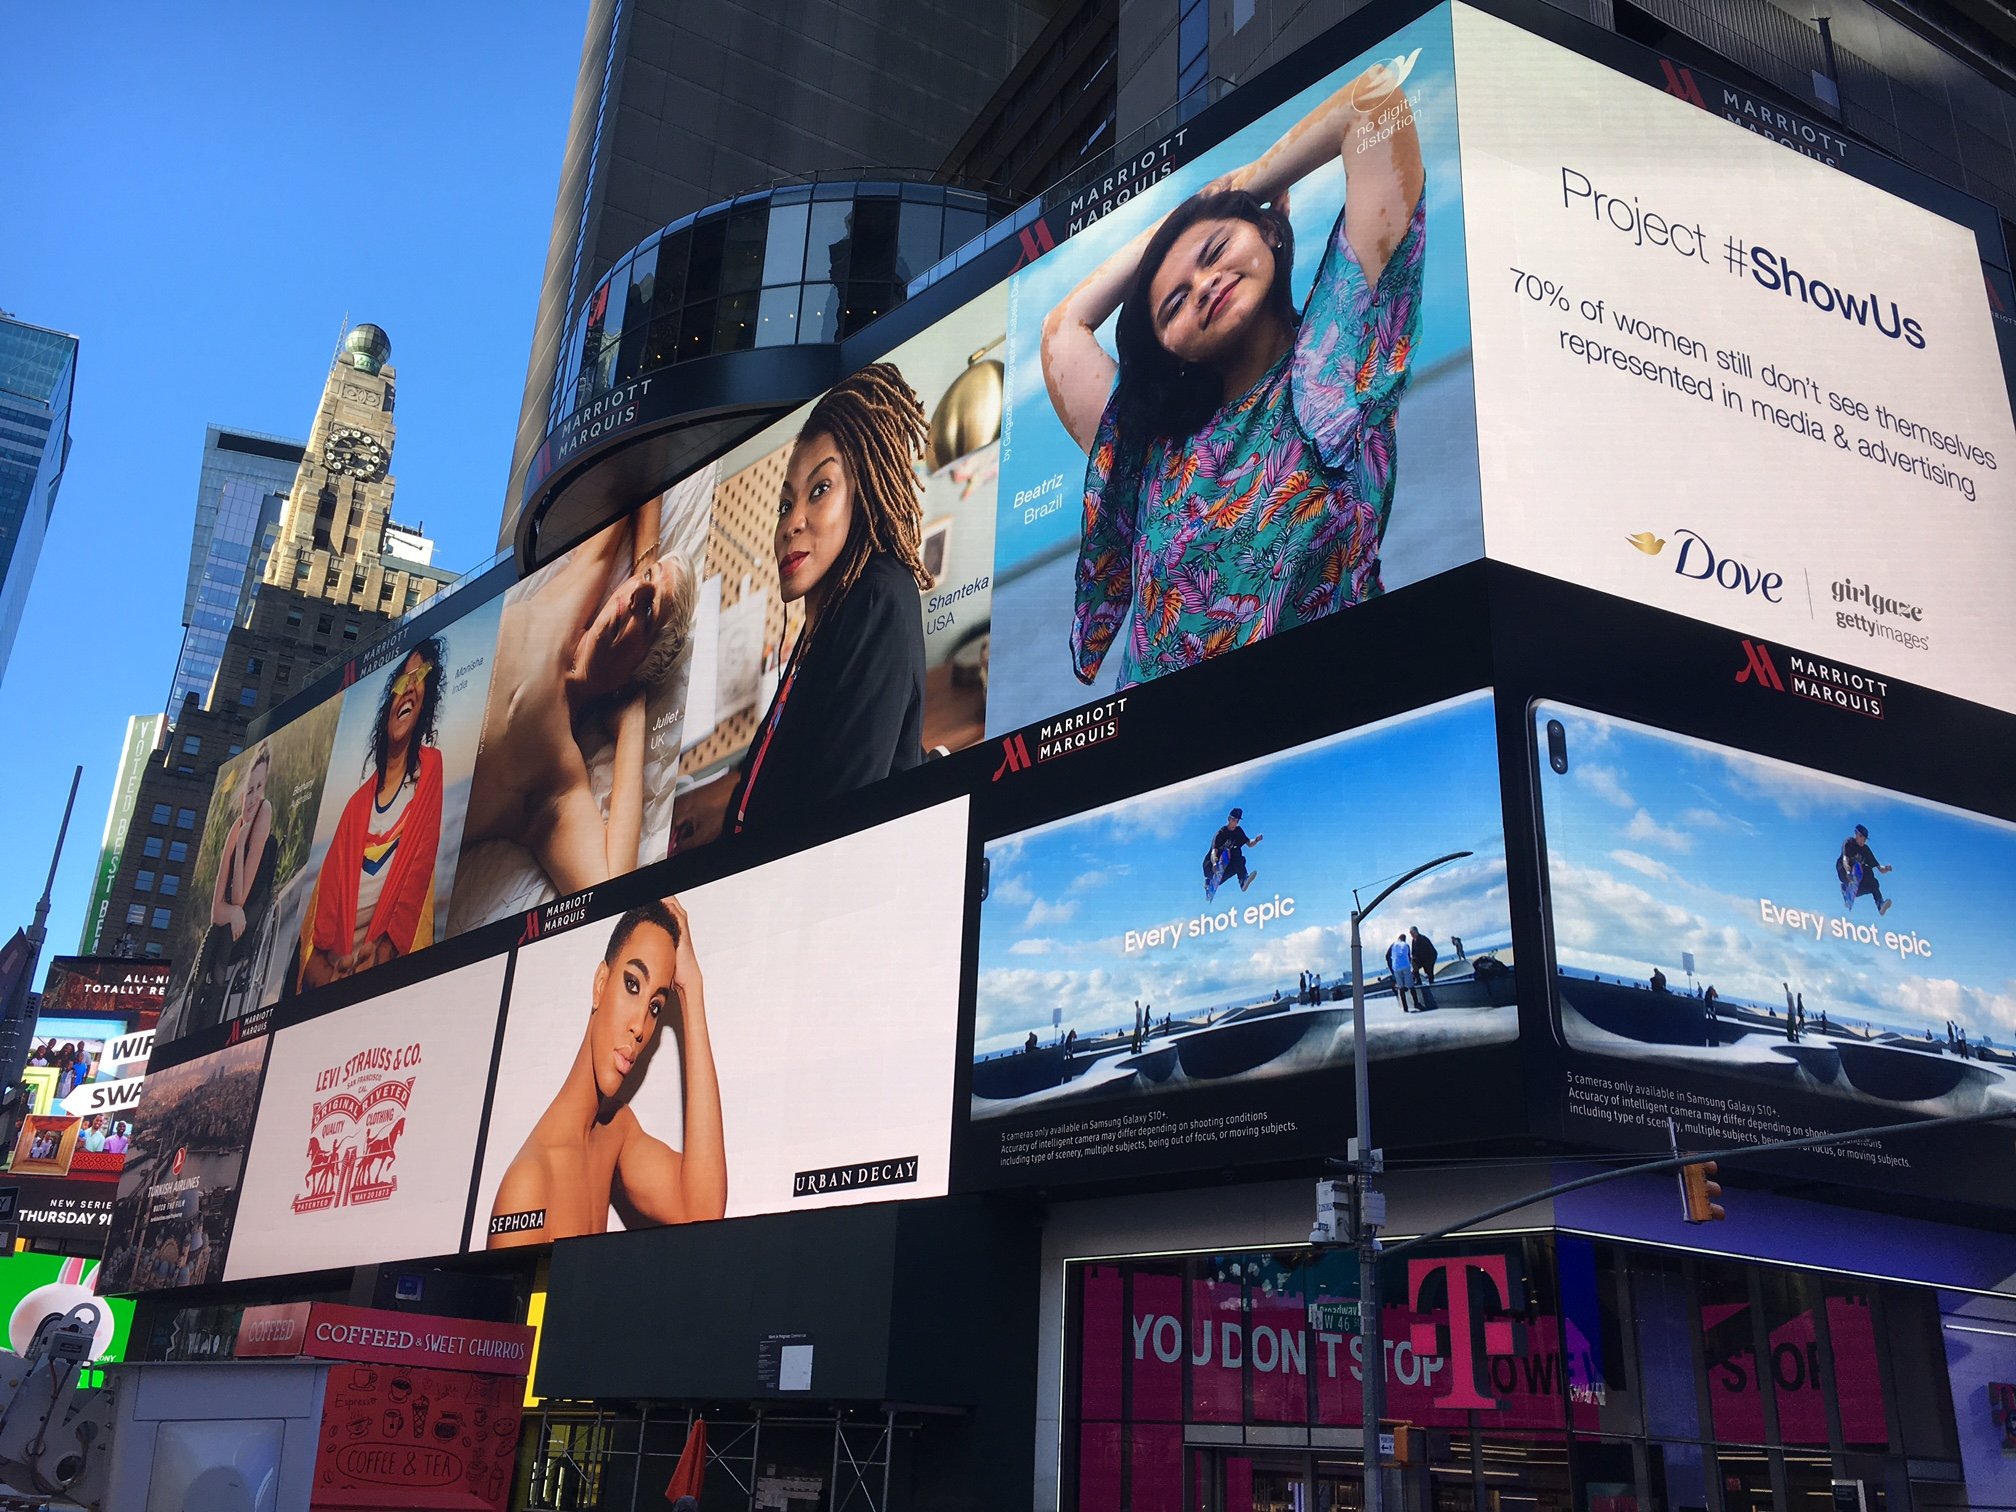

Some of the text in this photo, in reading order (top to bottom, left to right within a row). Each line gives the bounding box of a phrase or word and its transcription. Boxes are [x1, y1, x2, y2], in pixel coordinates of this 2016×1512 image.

[1356, 109, 1422, 154] distortion
[1357, 89, 1421, 139] no digital
[1723, 88, 1847, 157] MARRIOTT
[1070, 128, 1188, 216] MARRIOTT
[1068, 161, 1172, 238] MARQUIS
[1561, 166, 1926, 350] Project #ShowUs
[1509, 266, 1998, 470] 70% of women still don't see themselves
[561, 379, 652, 438] MARRIOTT
[1559, 329, 1977, 502] represented in media & advertising
[558, 406, 635, 460] MARQUIS
[1013, 473, 1064, 509] Beatriz
[1024, 494, 1063, 525] Brazil
[1674, 528, 1784, 604] Dove
[927, 576, 989, 613] Shanteka
[1831, 577, 1924, 622] girlgaze
[926, 611, 955, 635] USA
[1835, 610, 1930, 651] gettyimages
[359, 646, 401, 678] MARQUIS
[363, 627, 409, 664] MARRIOTT
[452, 679, 468, 694] India
[454, 656, 485, 680] Monisha
[1791, 656, 1888, 698] MARRIOTT
[1793, 677, 1881, 716] MARQUIS
[652, 709, 679, 732] Juliet
[1041, 698, 1127, 741] MARRIOTT
[650, 732, 666, 750] UK
[1040, 721, 1116, 760] MARQUIS
[105, 720, 151, 894] VOTED BEST
[543, 908, 586, 932] MARQUIS
[546, 891, 594, 918] MARRIOTT
[1125, 893, 1296, 953] Every shot epic
[1759, 898, 1932, 960] Every shot epic
[84, 984, 143, 995] TOTALLY
[241, 1021, 268, 1038] MARQUIS
[244, 1008, 274, 1026] MARRIOTT
[315, 1043, 422, 1092] LEVI STRAUSS & CO.
[347, 1074, 383, 1090] SAN FRANCISCO
[313, 1085, 408, 1125] ORIGINAL RIVETED
[1567, 1071, 1573, 1083] 5
[1574, 1074, 1613, 1090] cameras
[1614, 1081, 1634, 1095] only
[1635, 1084, 1675, 1100] available
[1676, 1090, 1685, 1101] in
[1686, 1092, 1726, 1110] Samsung
[1727, 1099, 1756, 1115] Galaxy
[322, 1108, 395, 1139] QUALITY CLOTHING
[1001, 1132, 1006, 1142] 5
[1006, 1129, 1034, 1141] cameras
[1034, 1126, 1049, 1138] only
[1049, 1122, 1081, 1136] available
[1081, 1121, 1088, 1131] in
[1089, 1118, 1121, 1130] Samsung
[1122, 1113, 1147, 1125] Galaxy
[1568, 1087, 1804, 1137] Accuracy of intelligent camera may differ depending on
[1569, 1102, 1760, 1145] including type of sceny, multiple subjects,
[1000, 1111, 1268, 1154] Accuracy of intelligent camera may differ depending on shooting conditions
[1000, 1121, 1299, 1166] including type of scenery, multiple subjects, being out of focus, or moving subjects.
[1837, 1149, 1912, 1168] or moving subjects.
[147, 1175, 200, 1198] TURKISH AIRLINES
[796, 1161, 916, 1194] URBAN DECAY
[50, 1199, 112, 1210] NEW SERIE
[296, 1199, 329, 1211] PATENTED
[354, 1193, 367, 1201] MAY
[18, 1209, 97, 1225] THURSDAY
[490, 1211, 544, 1234] SEPHORA
[1319, 1304, 1358, 1316] Broadway
[1324, 1314, 1350, 1331] W 46
[248, 1319, 296, 1342] COFFEED
[315, 1322, 525, 1361] COFFEED & SWEET CHURROS
[1133, 1314, 1212, 1365] YOU
[335, 1393, 378, 1409] Espresso
[347, 1449, 451, 1478] COFFEE & TEA
